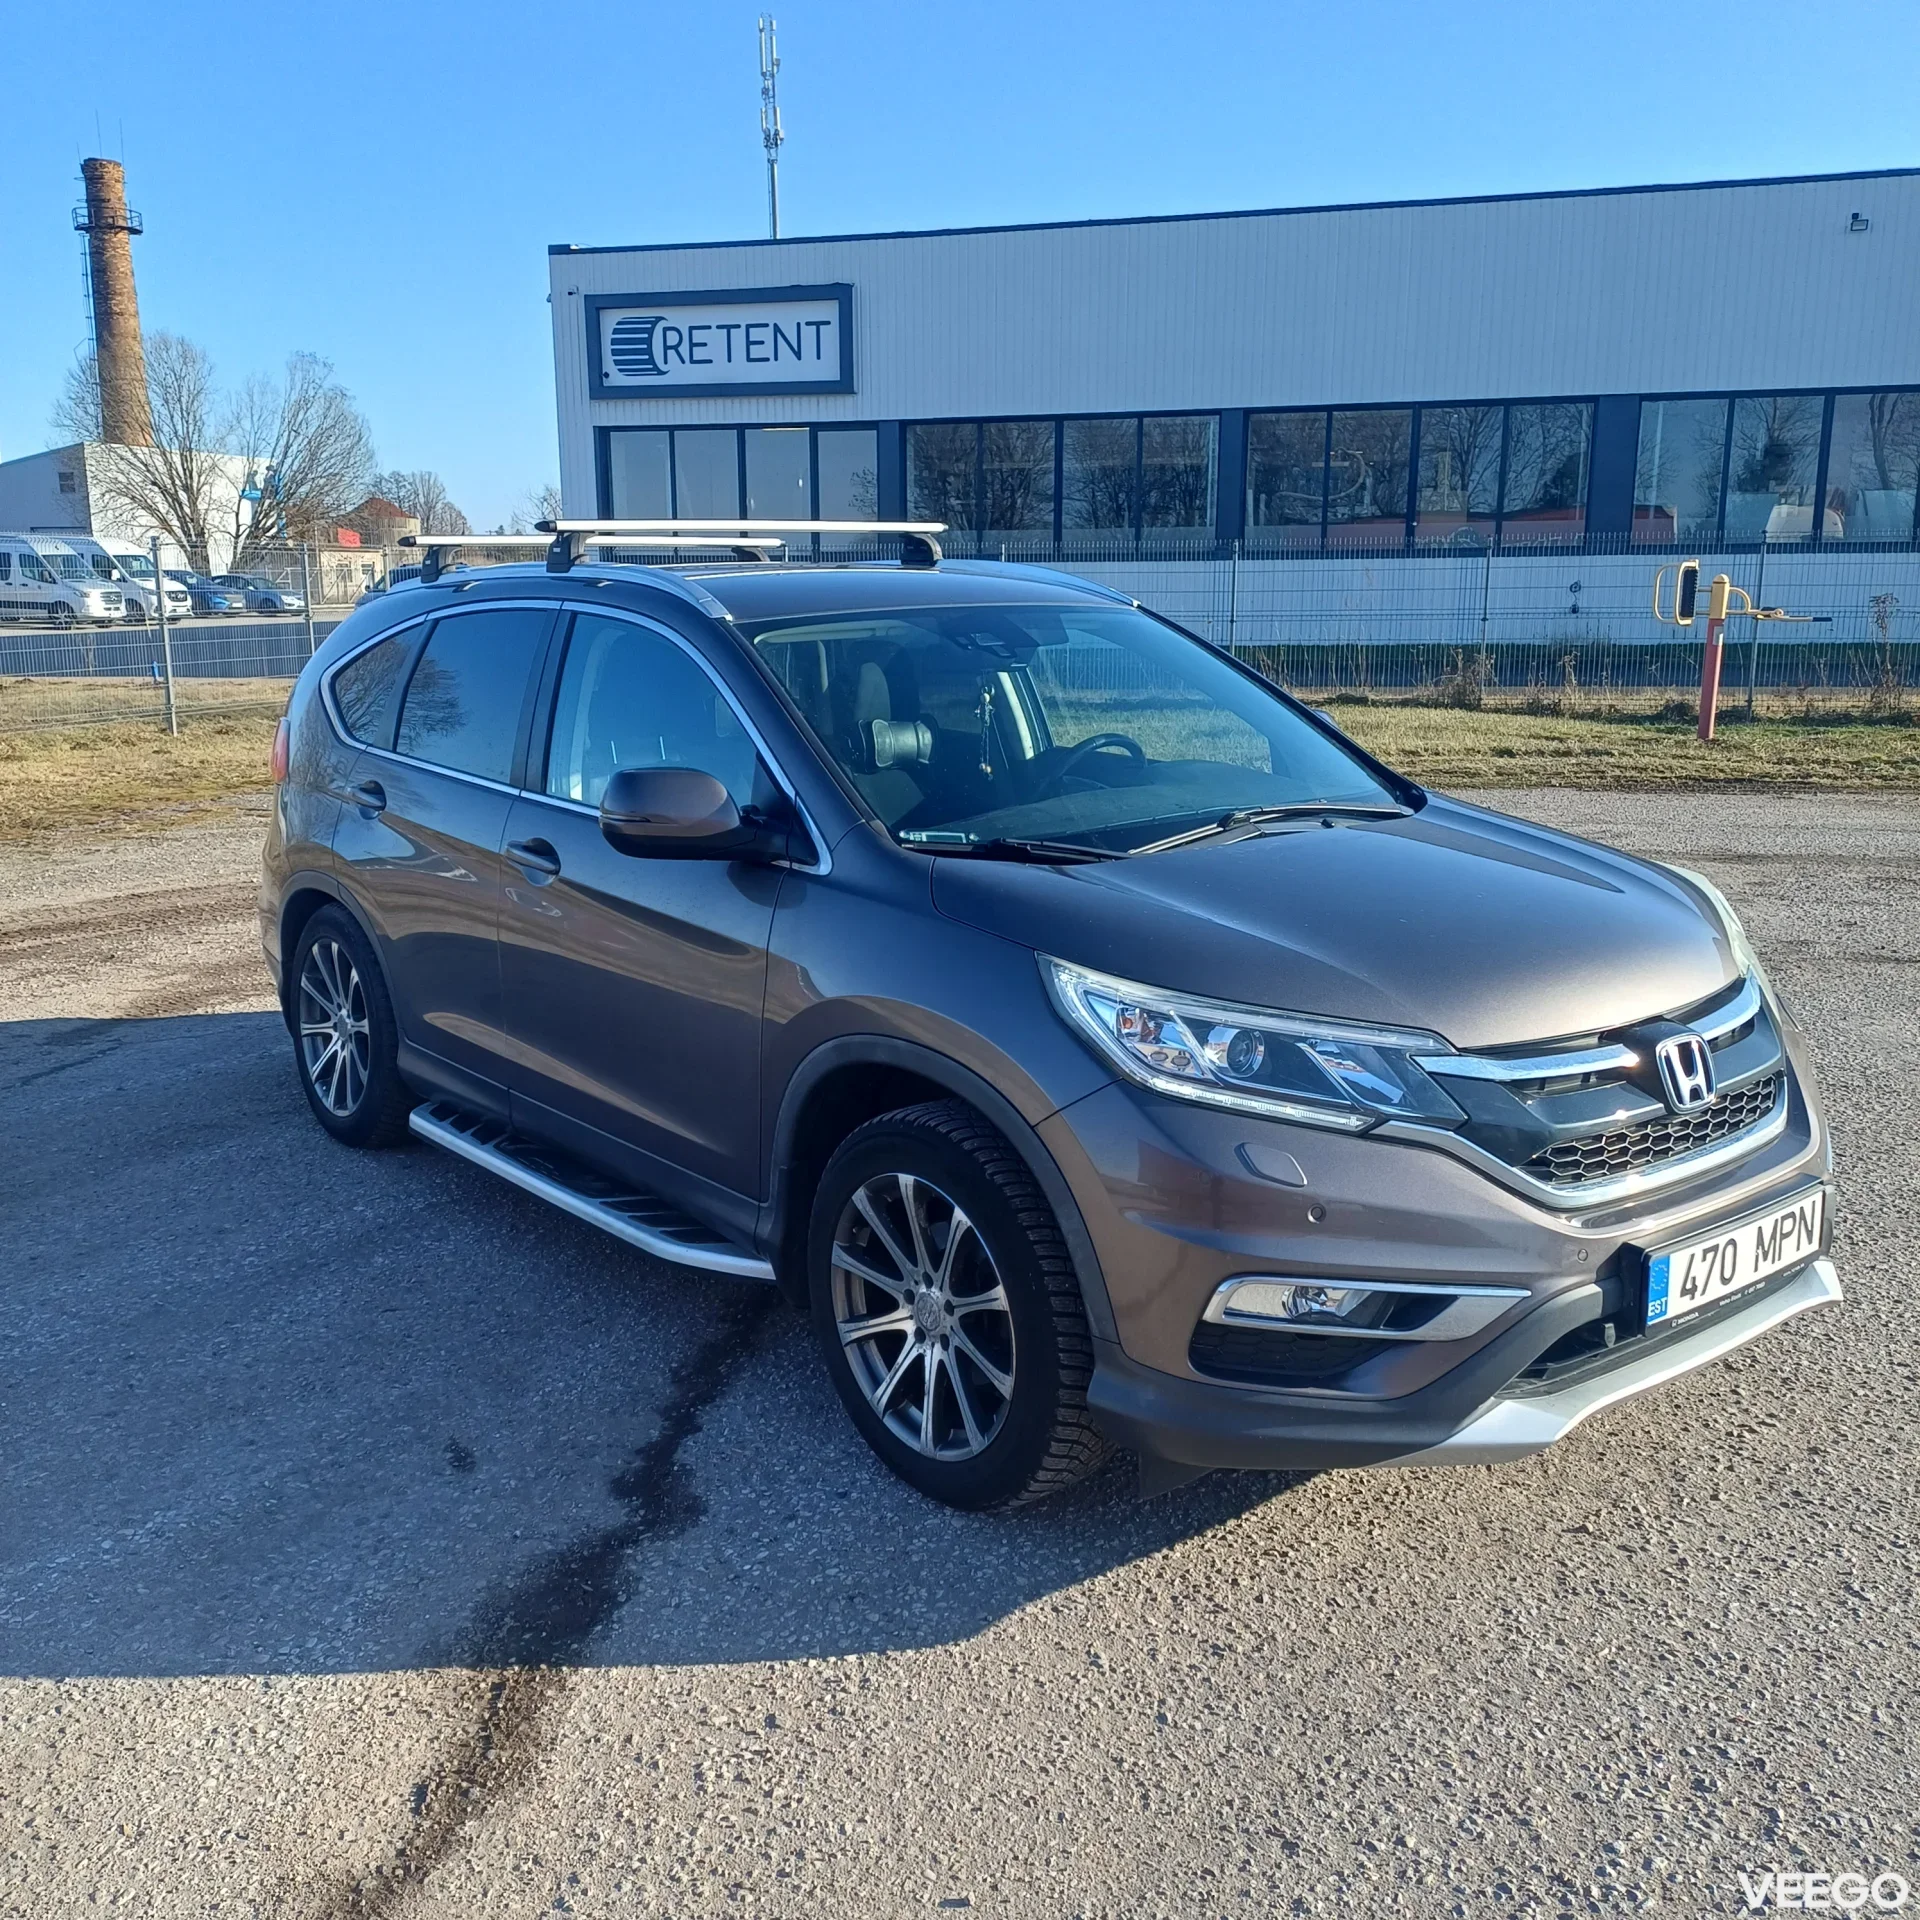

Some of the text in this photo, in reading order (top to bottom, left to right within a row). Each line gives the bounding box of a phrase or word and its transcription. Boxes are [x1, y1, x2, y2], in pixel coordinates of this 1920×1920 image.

[662, 320, 832, 365] RETENT
[1680, 1201, 1816, 1300] 470 MPN
[1648, 1297, 1668, 1317] EST
